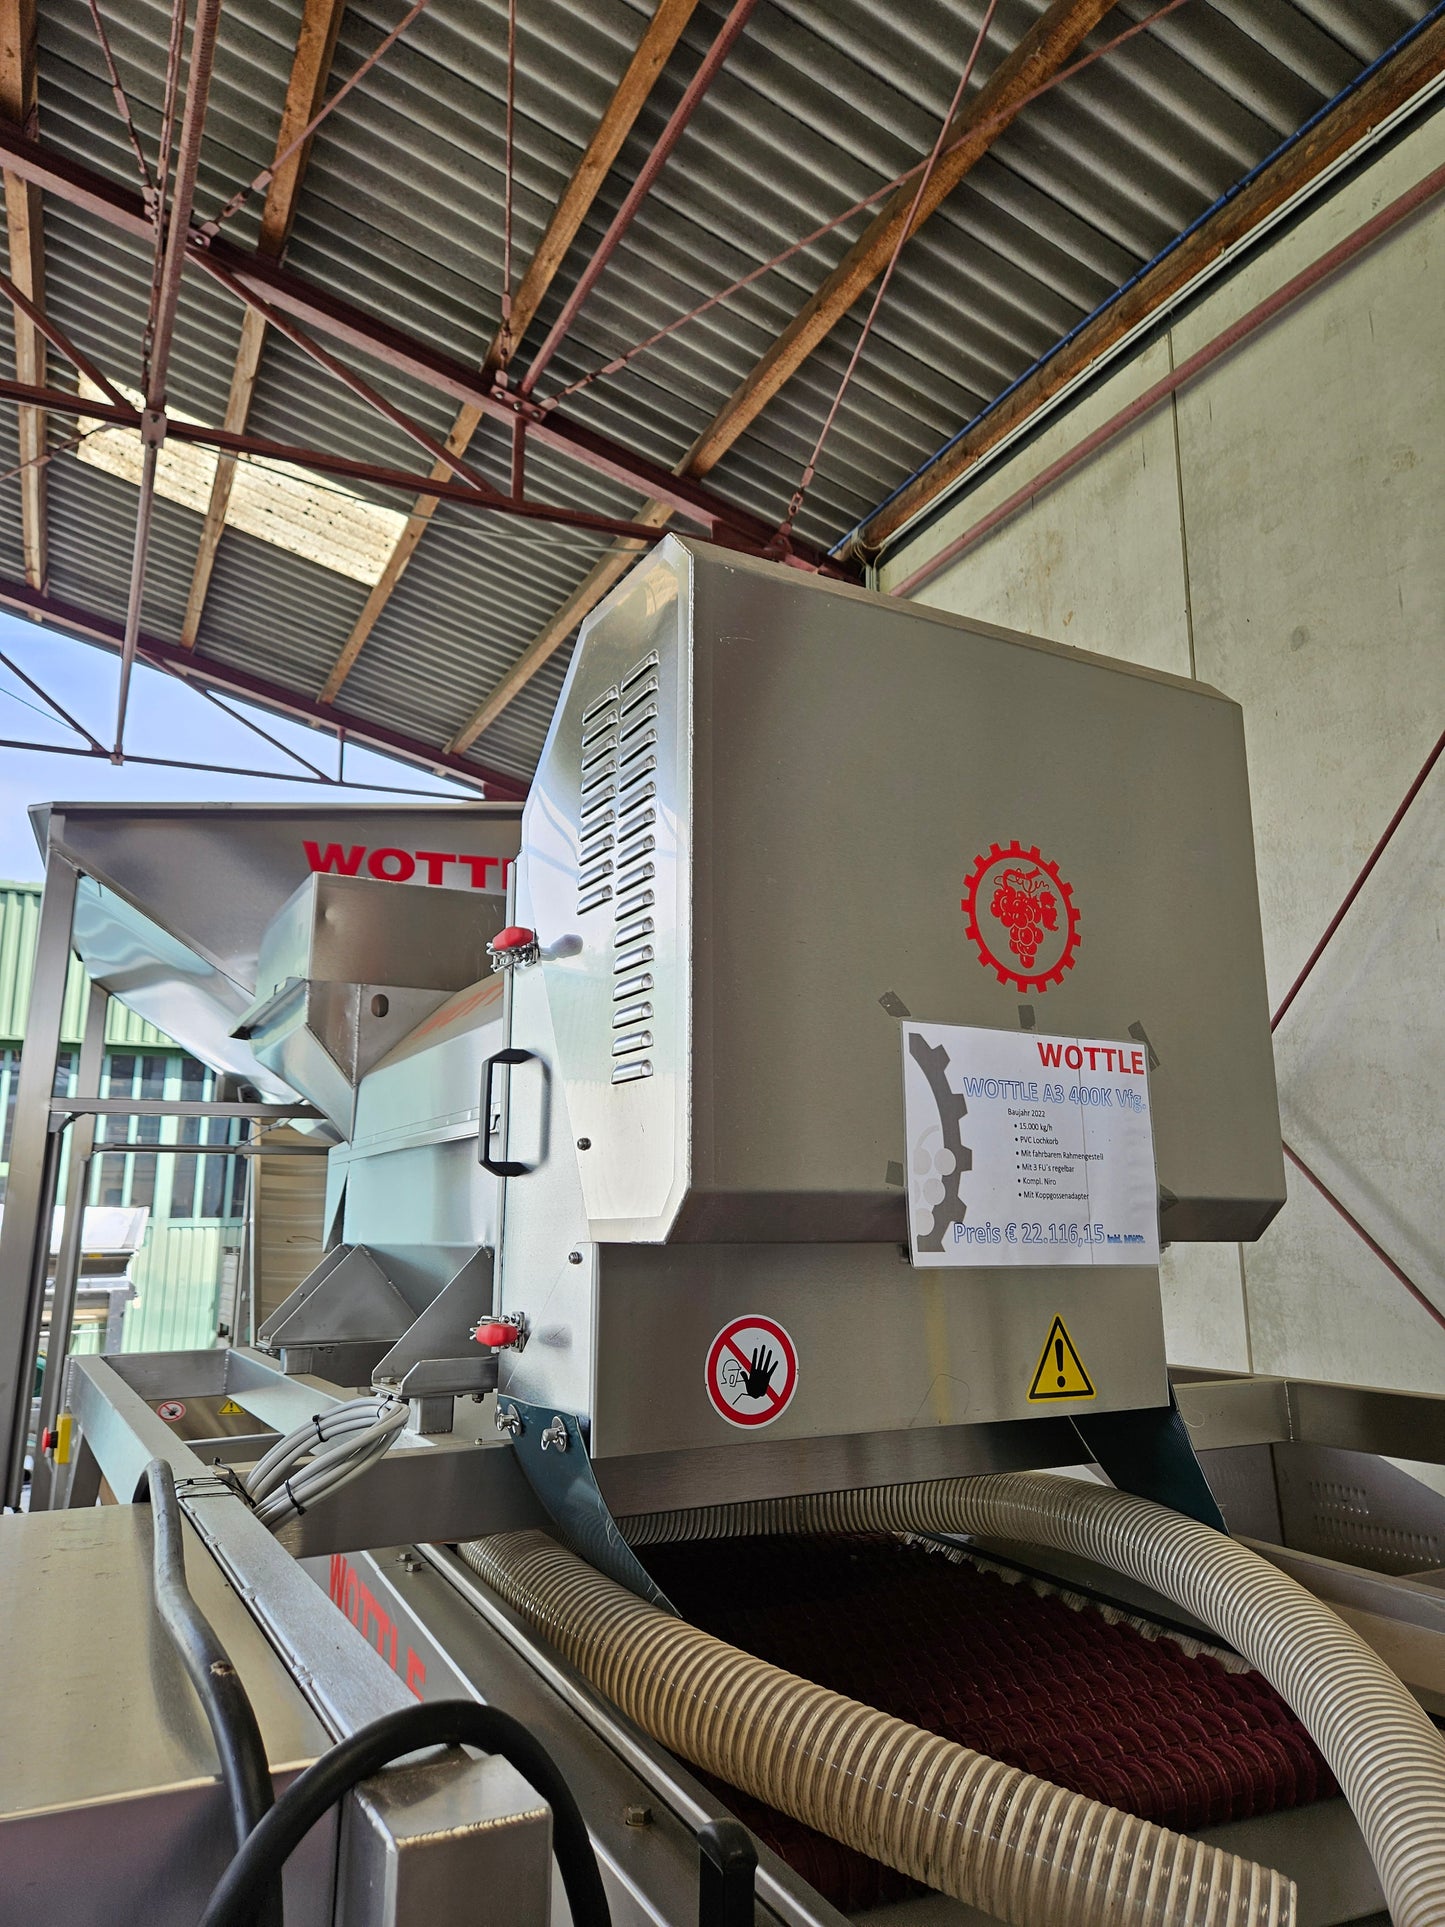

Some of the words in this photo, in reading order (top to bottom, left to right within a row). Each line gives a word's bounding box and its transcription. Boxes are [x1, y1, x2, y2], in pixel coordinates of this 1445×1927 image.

[302, 840, 507, 889] WOTT
[1037, 1042, 1145, 1075] WOTTLE
[964, 1077, 1039, 1102] WOTTLE
[1043, 1084, 1065, 1104] A3
[1068, 1086, 1112, 1107] 400K
[1117, 1088, 1147, 1113] Vfg.
[1007, 1108, 1030, 1118] Baujahr
[1031, 1109, 1046, 1118] 2022
[1019, 1122, 1039, 1131] 15.000
[1040, 1123, 1053, 1132] kg/h
[1020, 1136, 1032, 1144] PVC
[1033, 1137, 1059, 1145] Lochkorb
[1032, 1151, 1063, 1159] fahrbarem
[1063, 1152, 1104, 1161] Rahmengestell
[1052, 1165, 1075, 1174] regelbar
[1022, 1177, 1043, 1186] Kompl.
[1023, 1191, 1035, 1199] Mit
[953, 1222, 1002, 1244] Preis
[1005, 1223, 1017, 1244] €
[1022, 1223, 1105, 1247] 22.116,15
